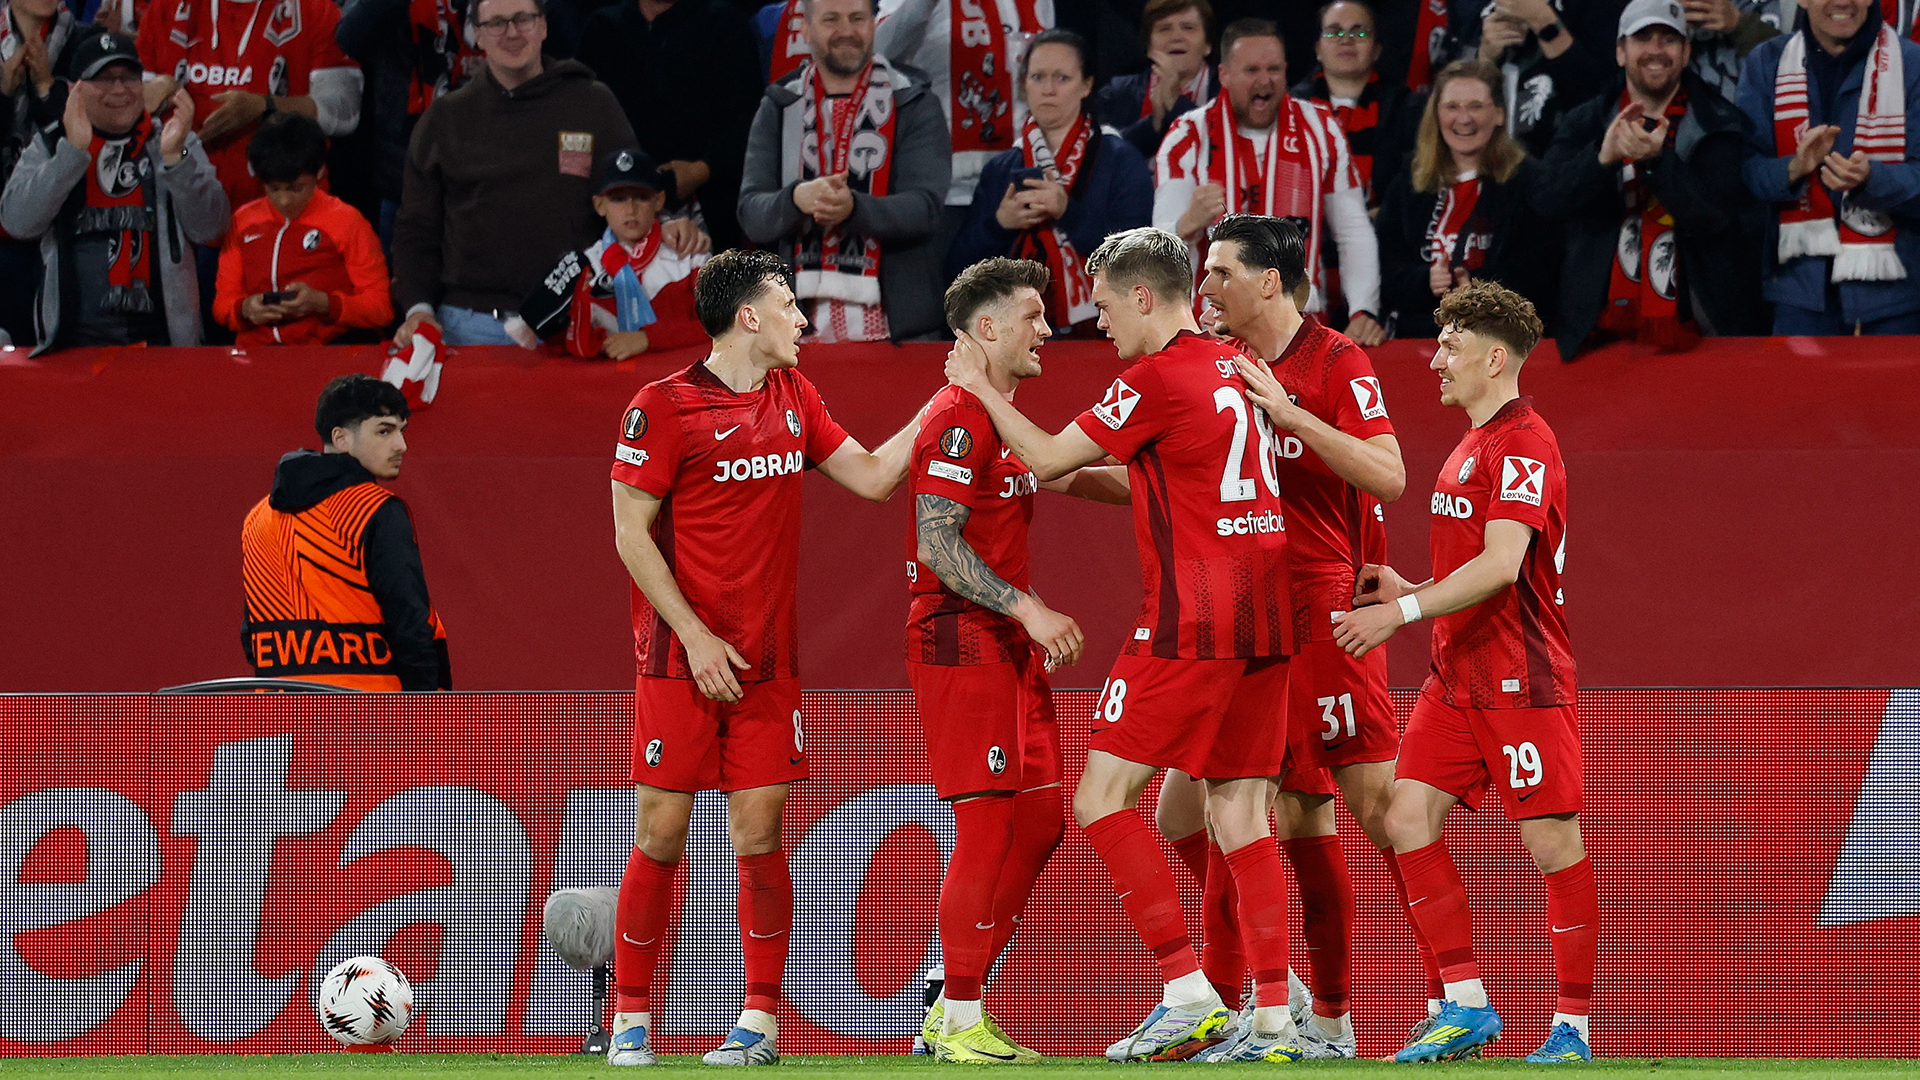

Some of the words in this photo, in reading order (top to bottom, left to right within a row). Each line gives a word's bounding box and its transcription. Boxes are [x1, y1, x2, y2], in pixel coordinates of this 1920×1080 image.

[1093, 405, 1120, 429] exware
[1212, 385, 1280, 502] 28
[712, 449, 803, 482] JOBRAD
[1431, 491, 1473, 519] BRAD
[251, 629, 392, 668] EWARD
[792, 709, 804, 753] 8
[1316, 692, 1357, 741] 31
[1502, 741, 1544, 789] 29
